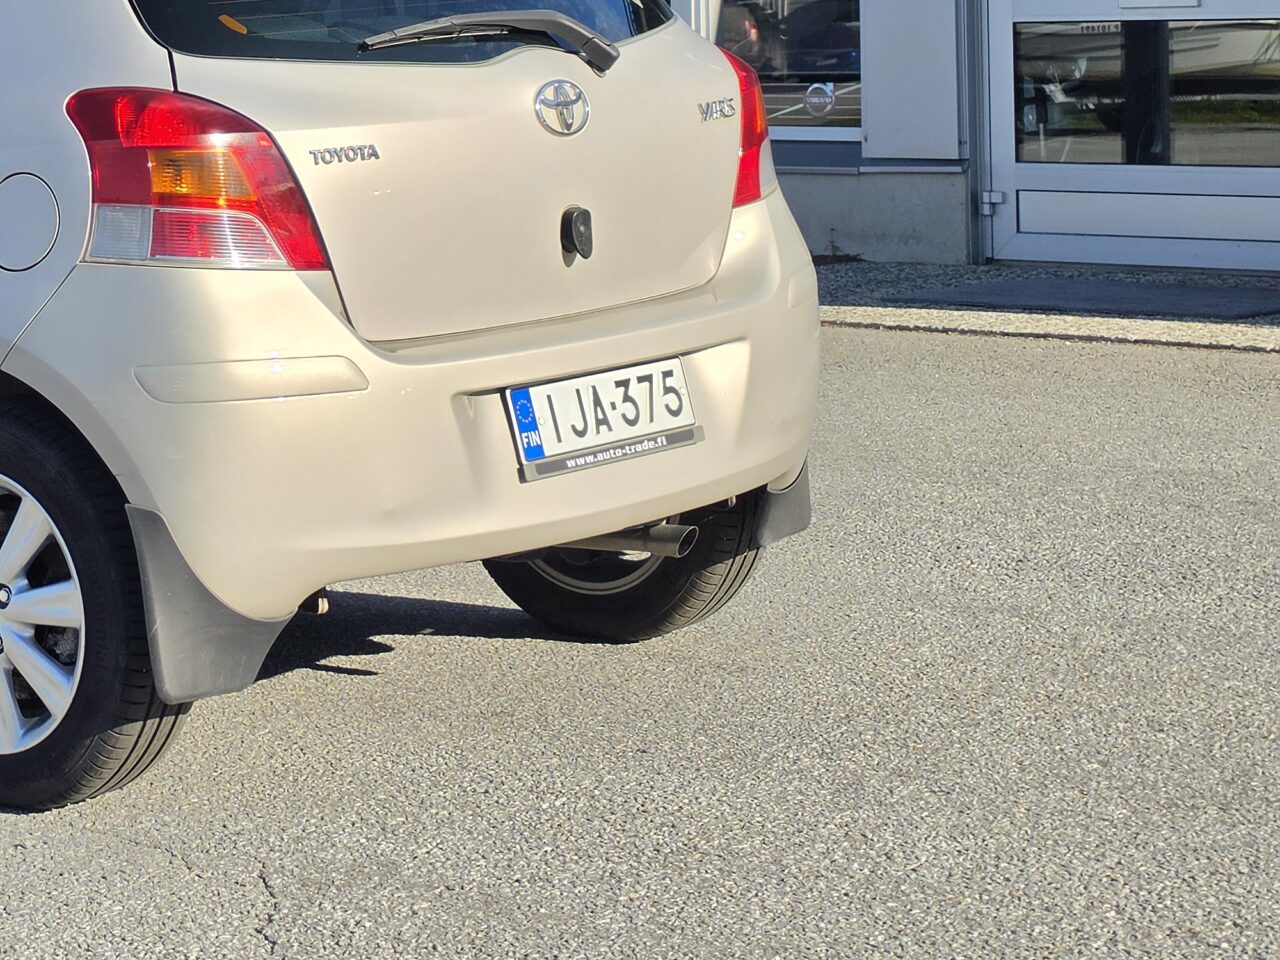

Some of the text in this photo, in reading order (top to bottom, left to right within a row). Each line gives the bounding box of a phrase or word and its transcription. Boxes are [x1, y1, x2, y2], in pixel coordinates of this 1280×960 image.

[309, 144, 380, 165] TOYOTA
[548, 369, 683, 443] IJA-375
[521, 431, 541, 448] FIN
[566, 437, 668, 468] www.auto-trade.fi
